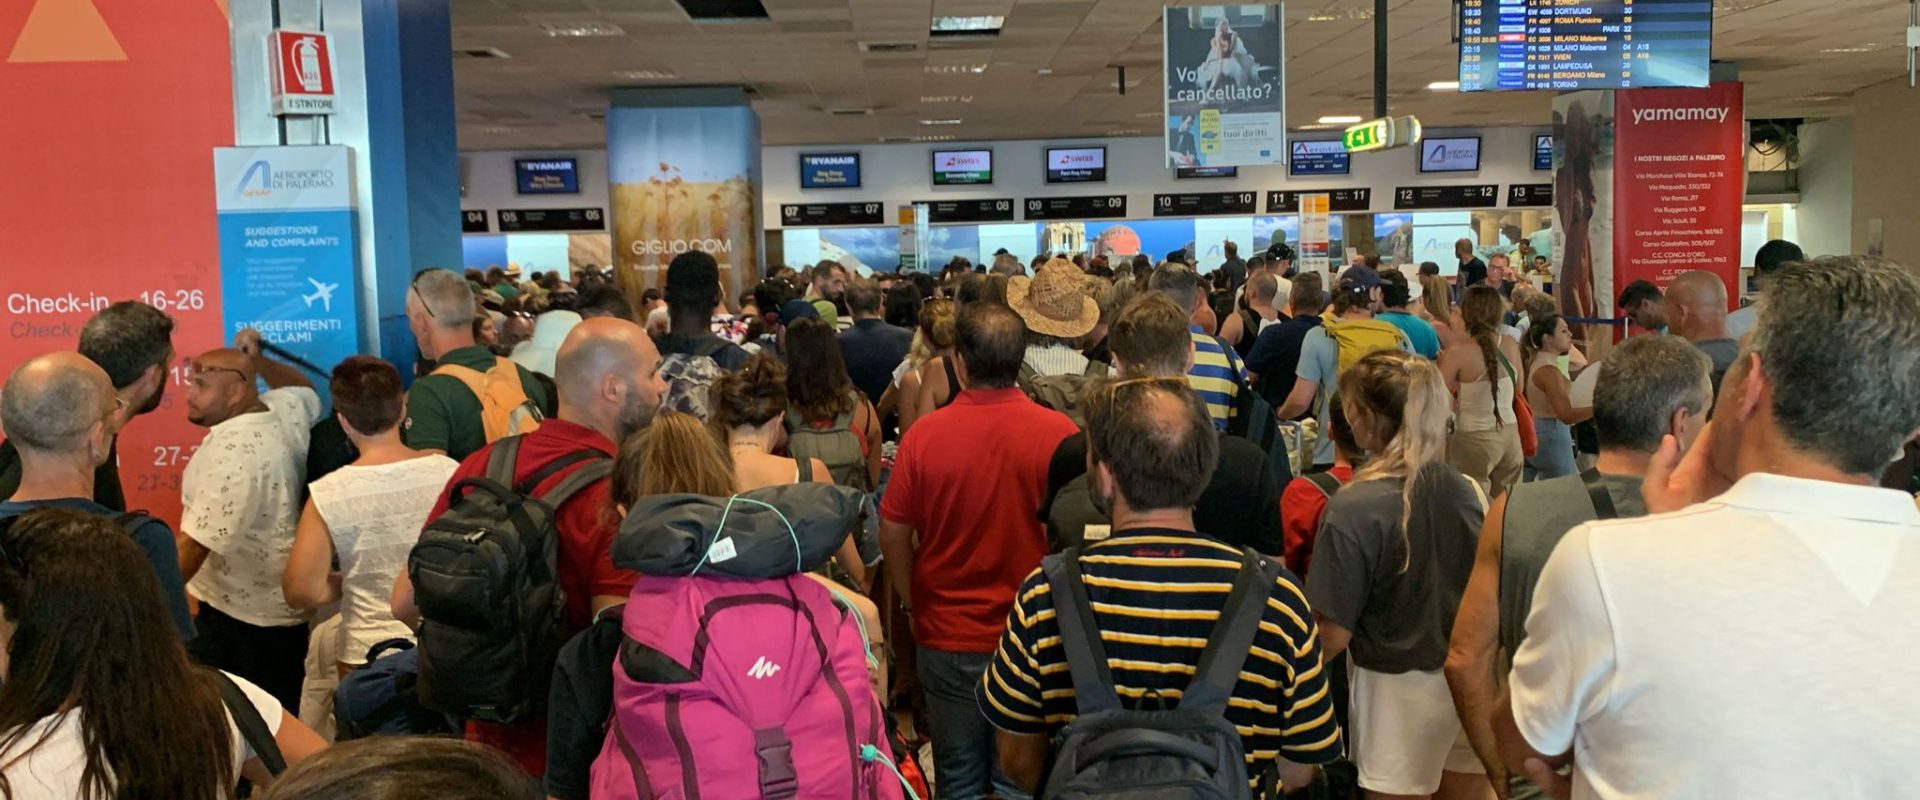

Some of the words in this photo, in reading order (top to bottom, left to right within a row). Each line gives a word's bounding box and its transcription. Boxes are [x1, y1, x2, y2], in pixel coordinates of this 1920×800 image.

[1177, 84, 1272, 101] cancellato?
[289, 99, 333, 109] ESTINTORE
[1632, 107, 1729, 125] yamamay
[1224, 130, 1240, 138] tuoi
[1243, 129, 1267, 137] diritti
[527, 162, 572, 170] RYANAIR
[811, 157, 855, 165] RYANAIR
[273, 170, 333, 180] AEROPORTO
[273, 180, 283, 189] DI
[286, 179, 334, 189] PALERMO
[1273, 193, 1284, 204] 11
[1353, 190, 1365, 200] 11
[1401, 190, 1413, 200] 12
[1480, 187, 1493, 197] 12
[1513, 187, 1526, 197] 13
[996, 201, 1009, 211] 08
[1029, 201, 1042, 211] 09
[1108, 198, 1122, 208] 09
[1158, 197, 1171, 207] 10
[1239, 193, 1252, 204] 10
[502, 212, 517, 222] 05
[586, 210, 600, 220] 05
[785, 206, 799, 217] 07
[865, 204, 879, 214] 07
[468, 212, 482, 222] 04
[245, 225, 318, 236] SUGGESTIONS
[245, 238, 269, 248] AND
[271, 237, 339, 247] COMPLAINTS
[632, 239, 731, 255] GIGLIO.COM
[8, 292, 109, 313] Check-in
[140, 290, 204, 310] 16-26
[10, 321, 79, 339] Check-
[235, 319, 341, 332] SUGGERIMENTI
